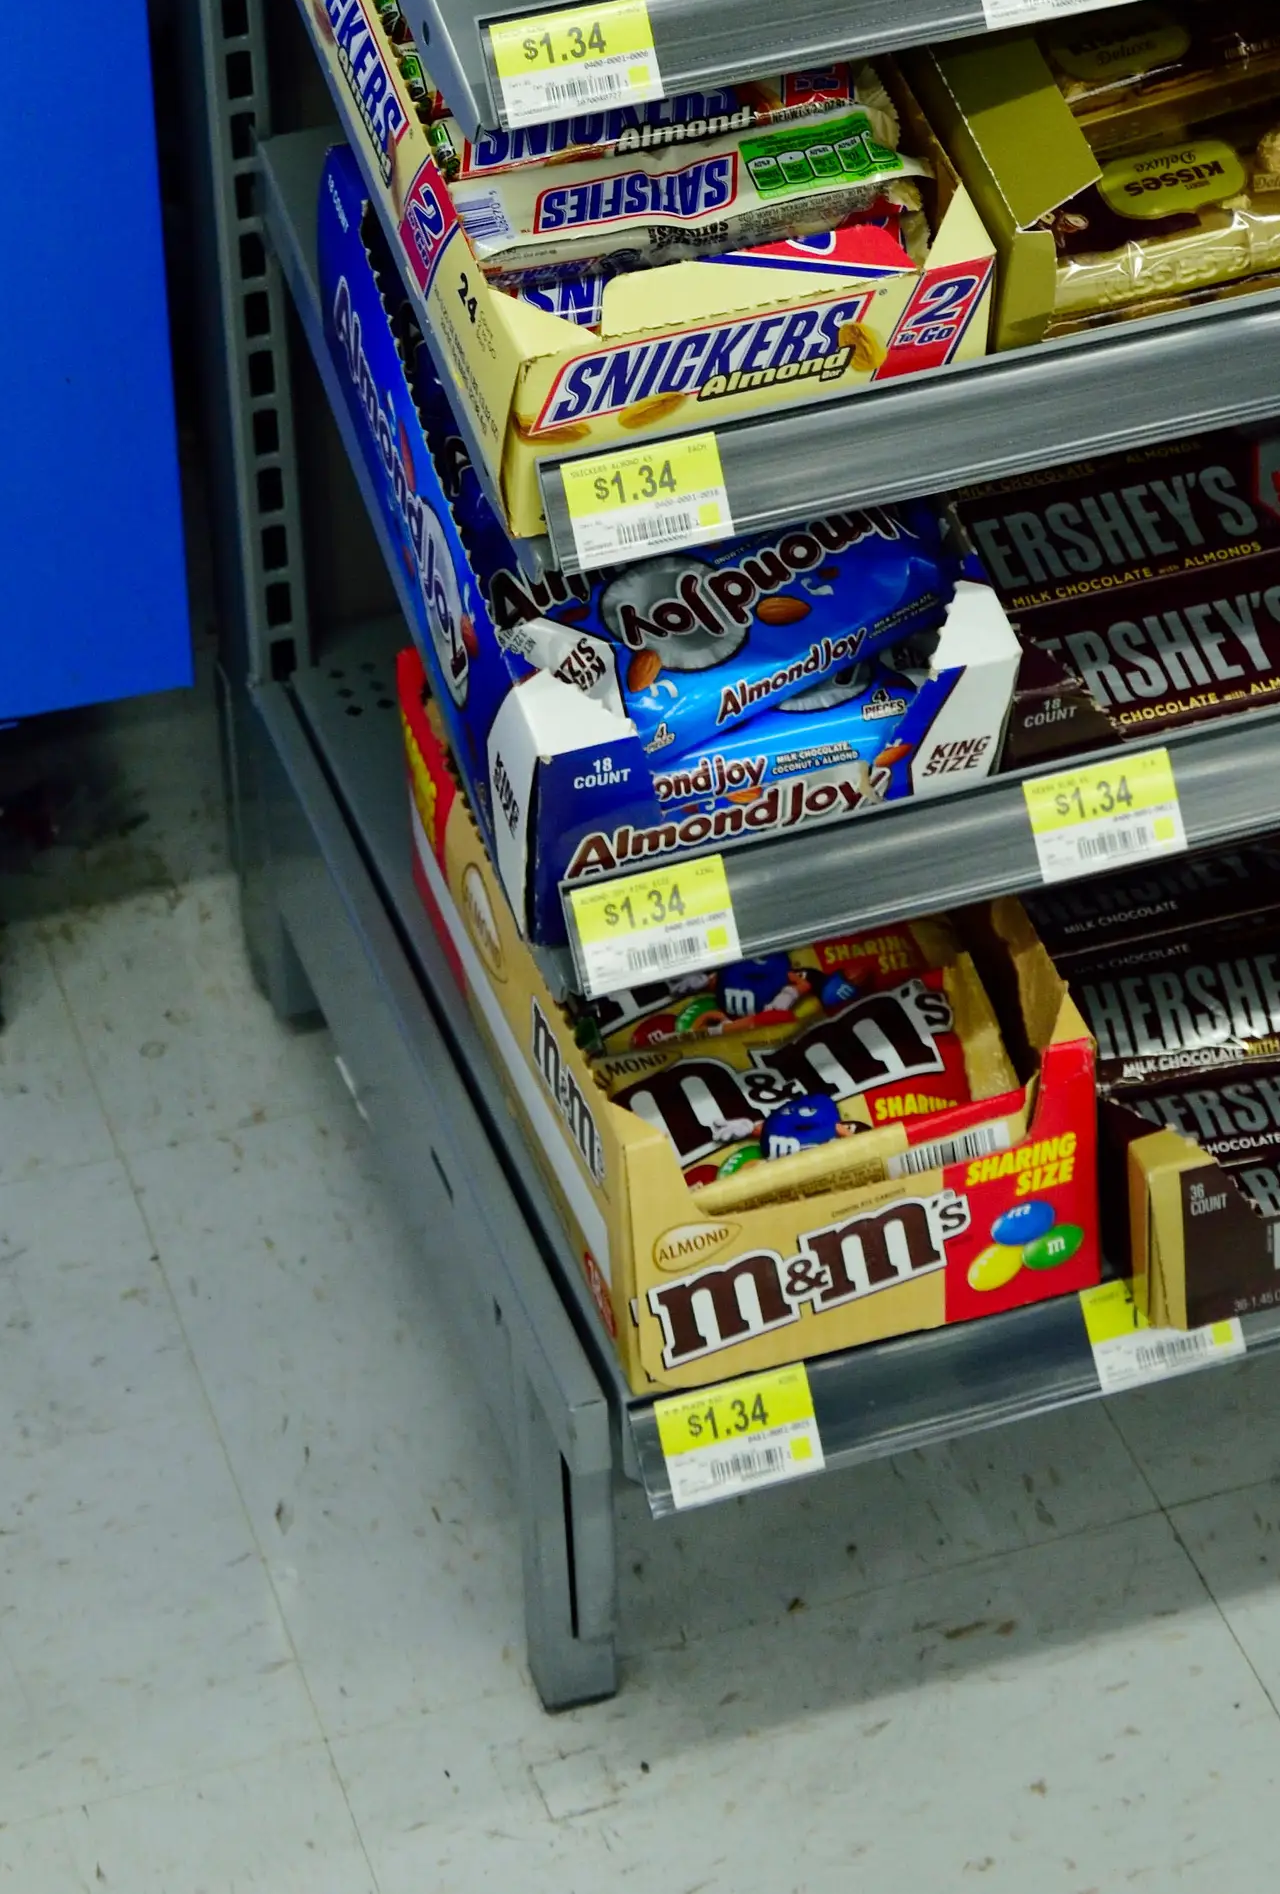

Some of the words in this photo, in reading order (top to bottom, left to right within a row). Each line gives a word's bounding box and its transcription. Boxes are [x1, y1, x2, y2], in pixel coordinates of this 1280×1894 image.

[521, 22, 607, 64] $1.34
[554, 297, 866, 423] SNICKERS
[700, 348, 849, 402] Almond
[593, 459, 677, 504] $1.34
[1055, 566, 1153, 604] CHOCOLATE
[1184, 541, 1262, 568] ALMONDS
[1119, 692, 1220, 727] CHOCOLATE
[592, 758, 613, 772] 18
[921, 754, 981, 777] SIZE
[933, 736, 991, 759] KING
[573, 768, 631, 790] COUNT
[1054, 775, 1133, 819] $1.34
[604, 887, 687, 929] $1.34
[966, 1132, 1078, 1188] SHARING
[1016, 1159, 1075, 1197] SIZE
[657, 1224, 732, 1264] ALMOND
[688, 1392, 770, 1440] $1.34
